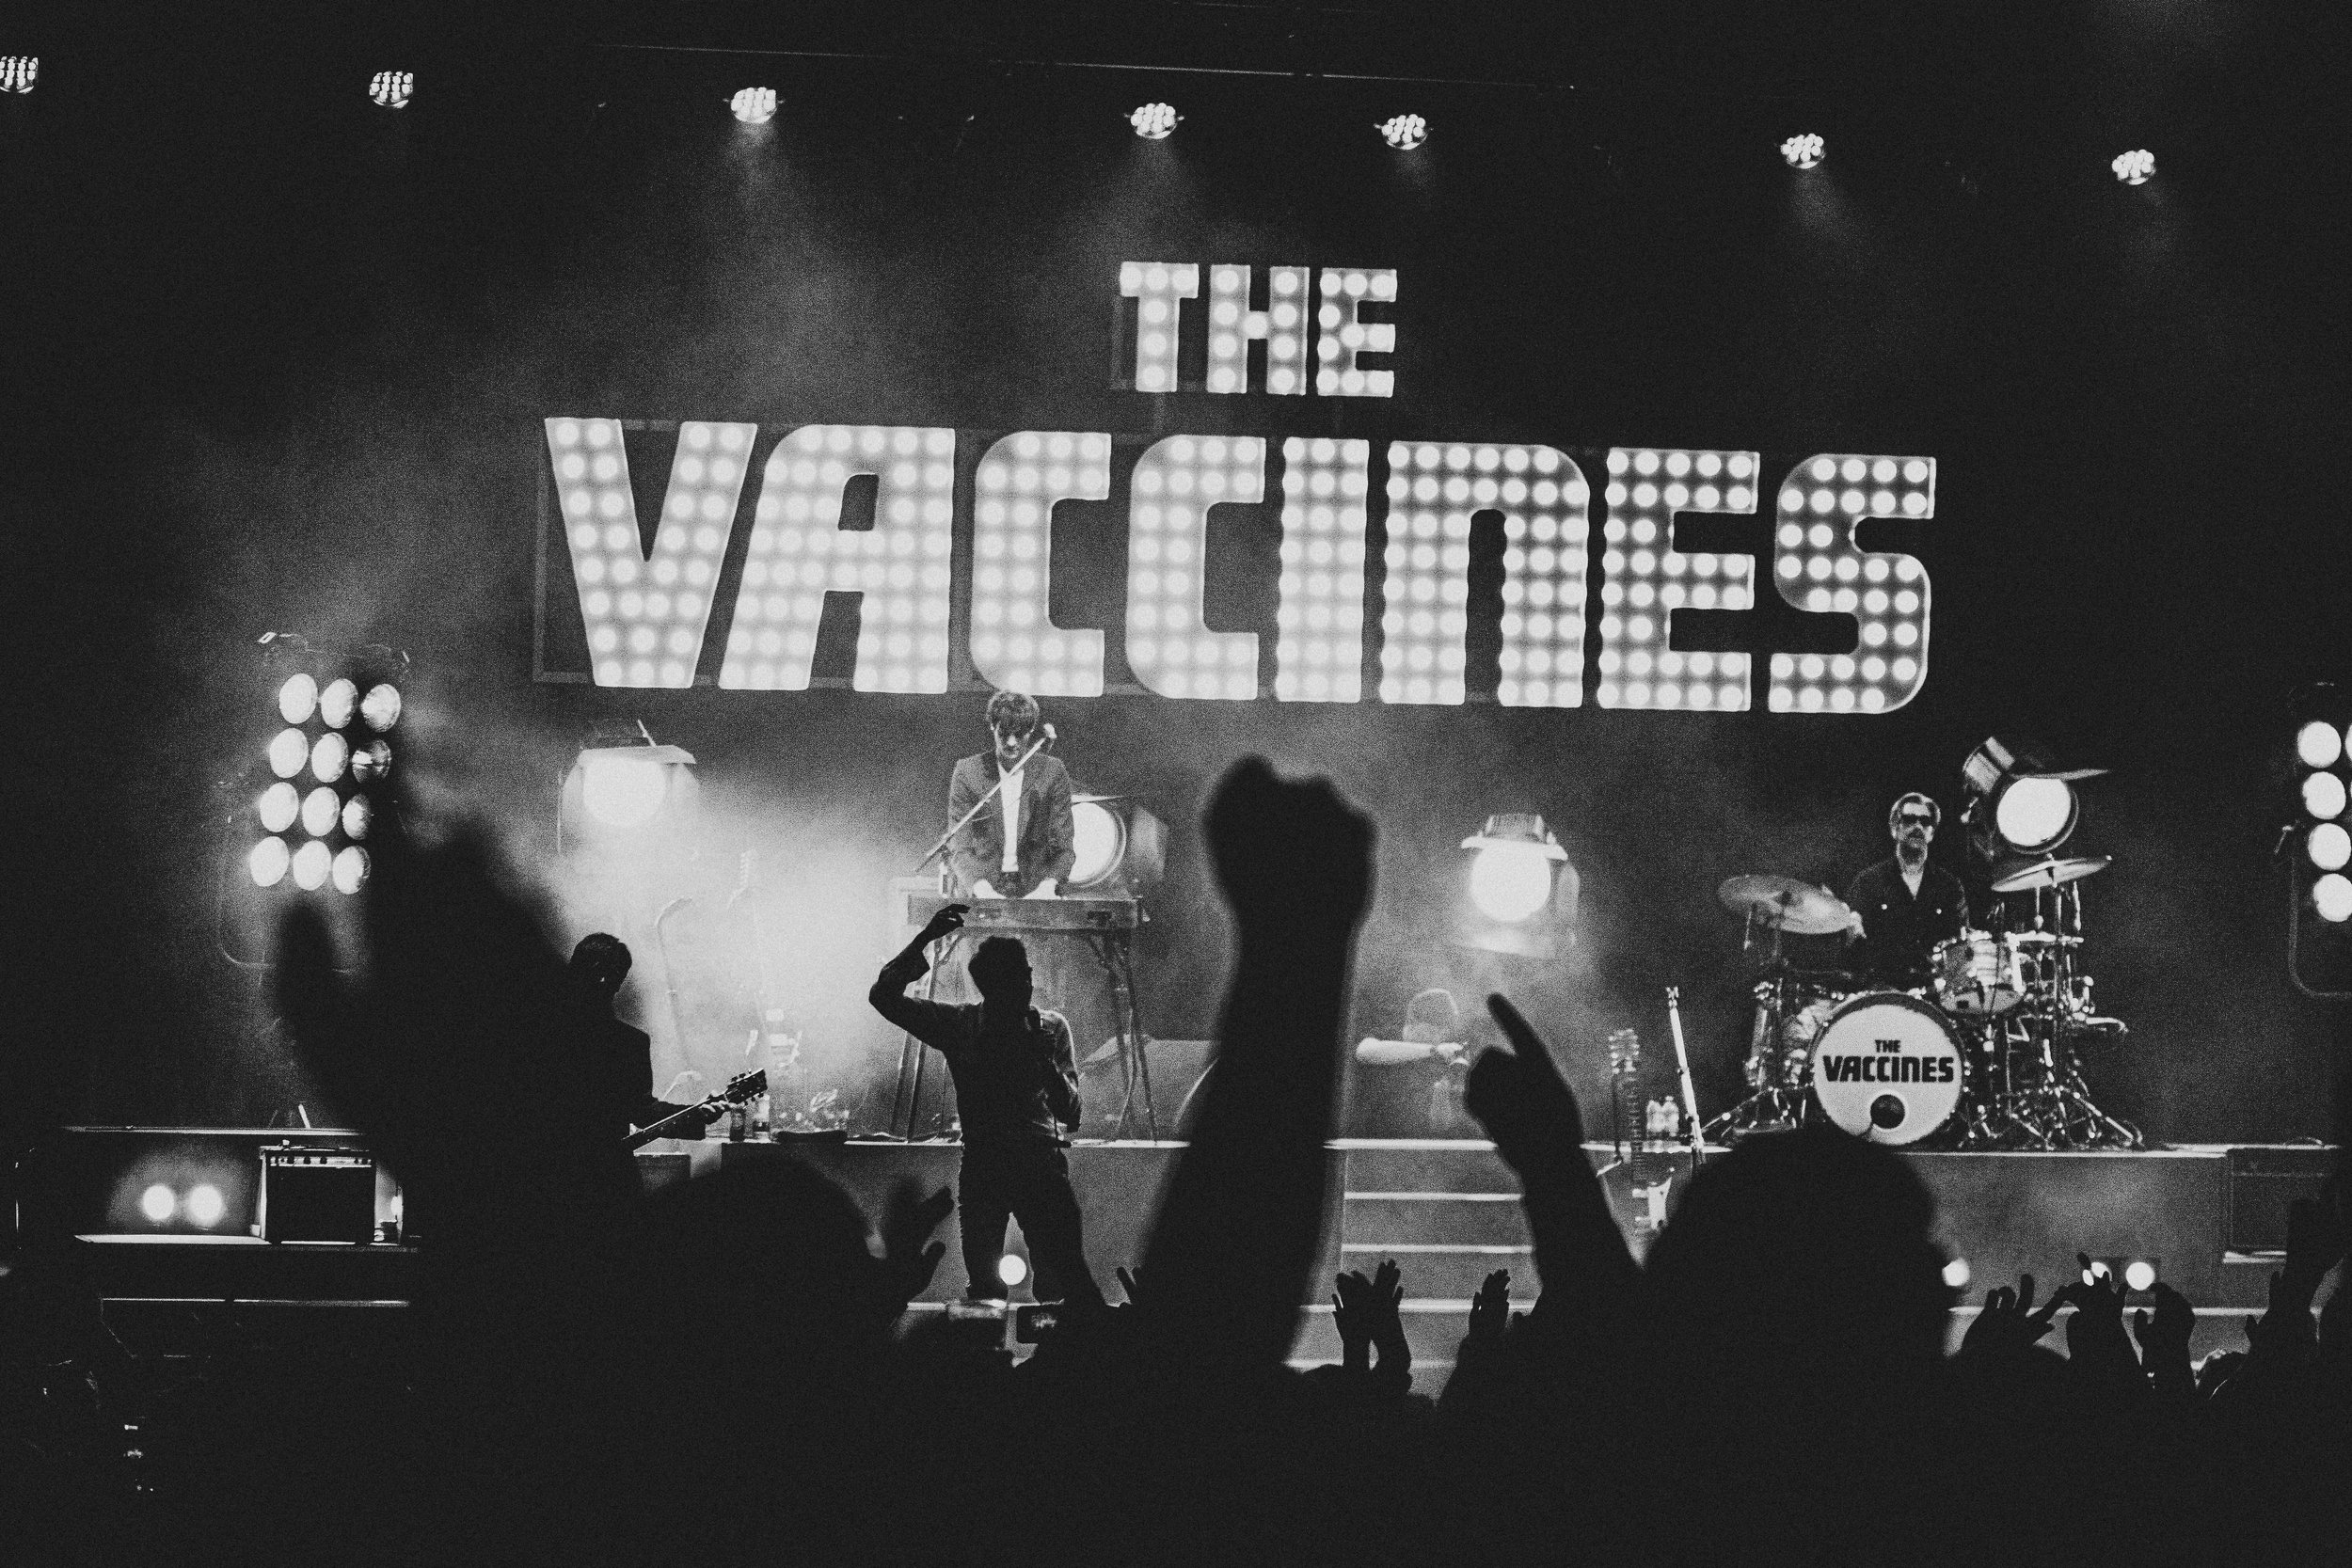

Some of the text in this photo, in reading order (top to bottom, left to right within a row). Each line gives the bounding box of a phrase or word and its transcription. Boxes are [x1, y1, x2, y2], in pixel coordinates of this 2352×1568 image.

[1120, 261, 1397, 398] THE
[545, 418, 1936, 715] VACCINES
[1822, 1055, 1954, 1083] VACCINES
[1875, 1039, 1901, 1053] THE
